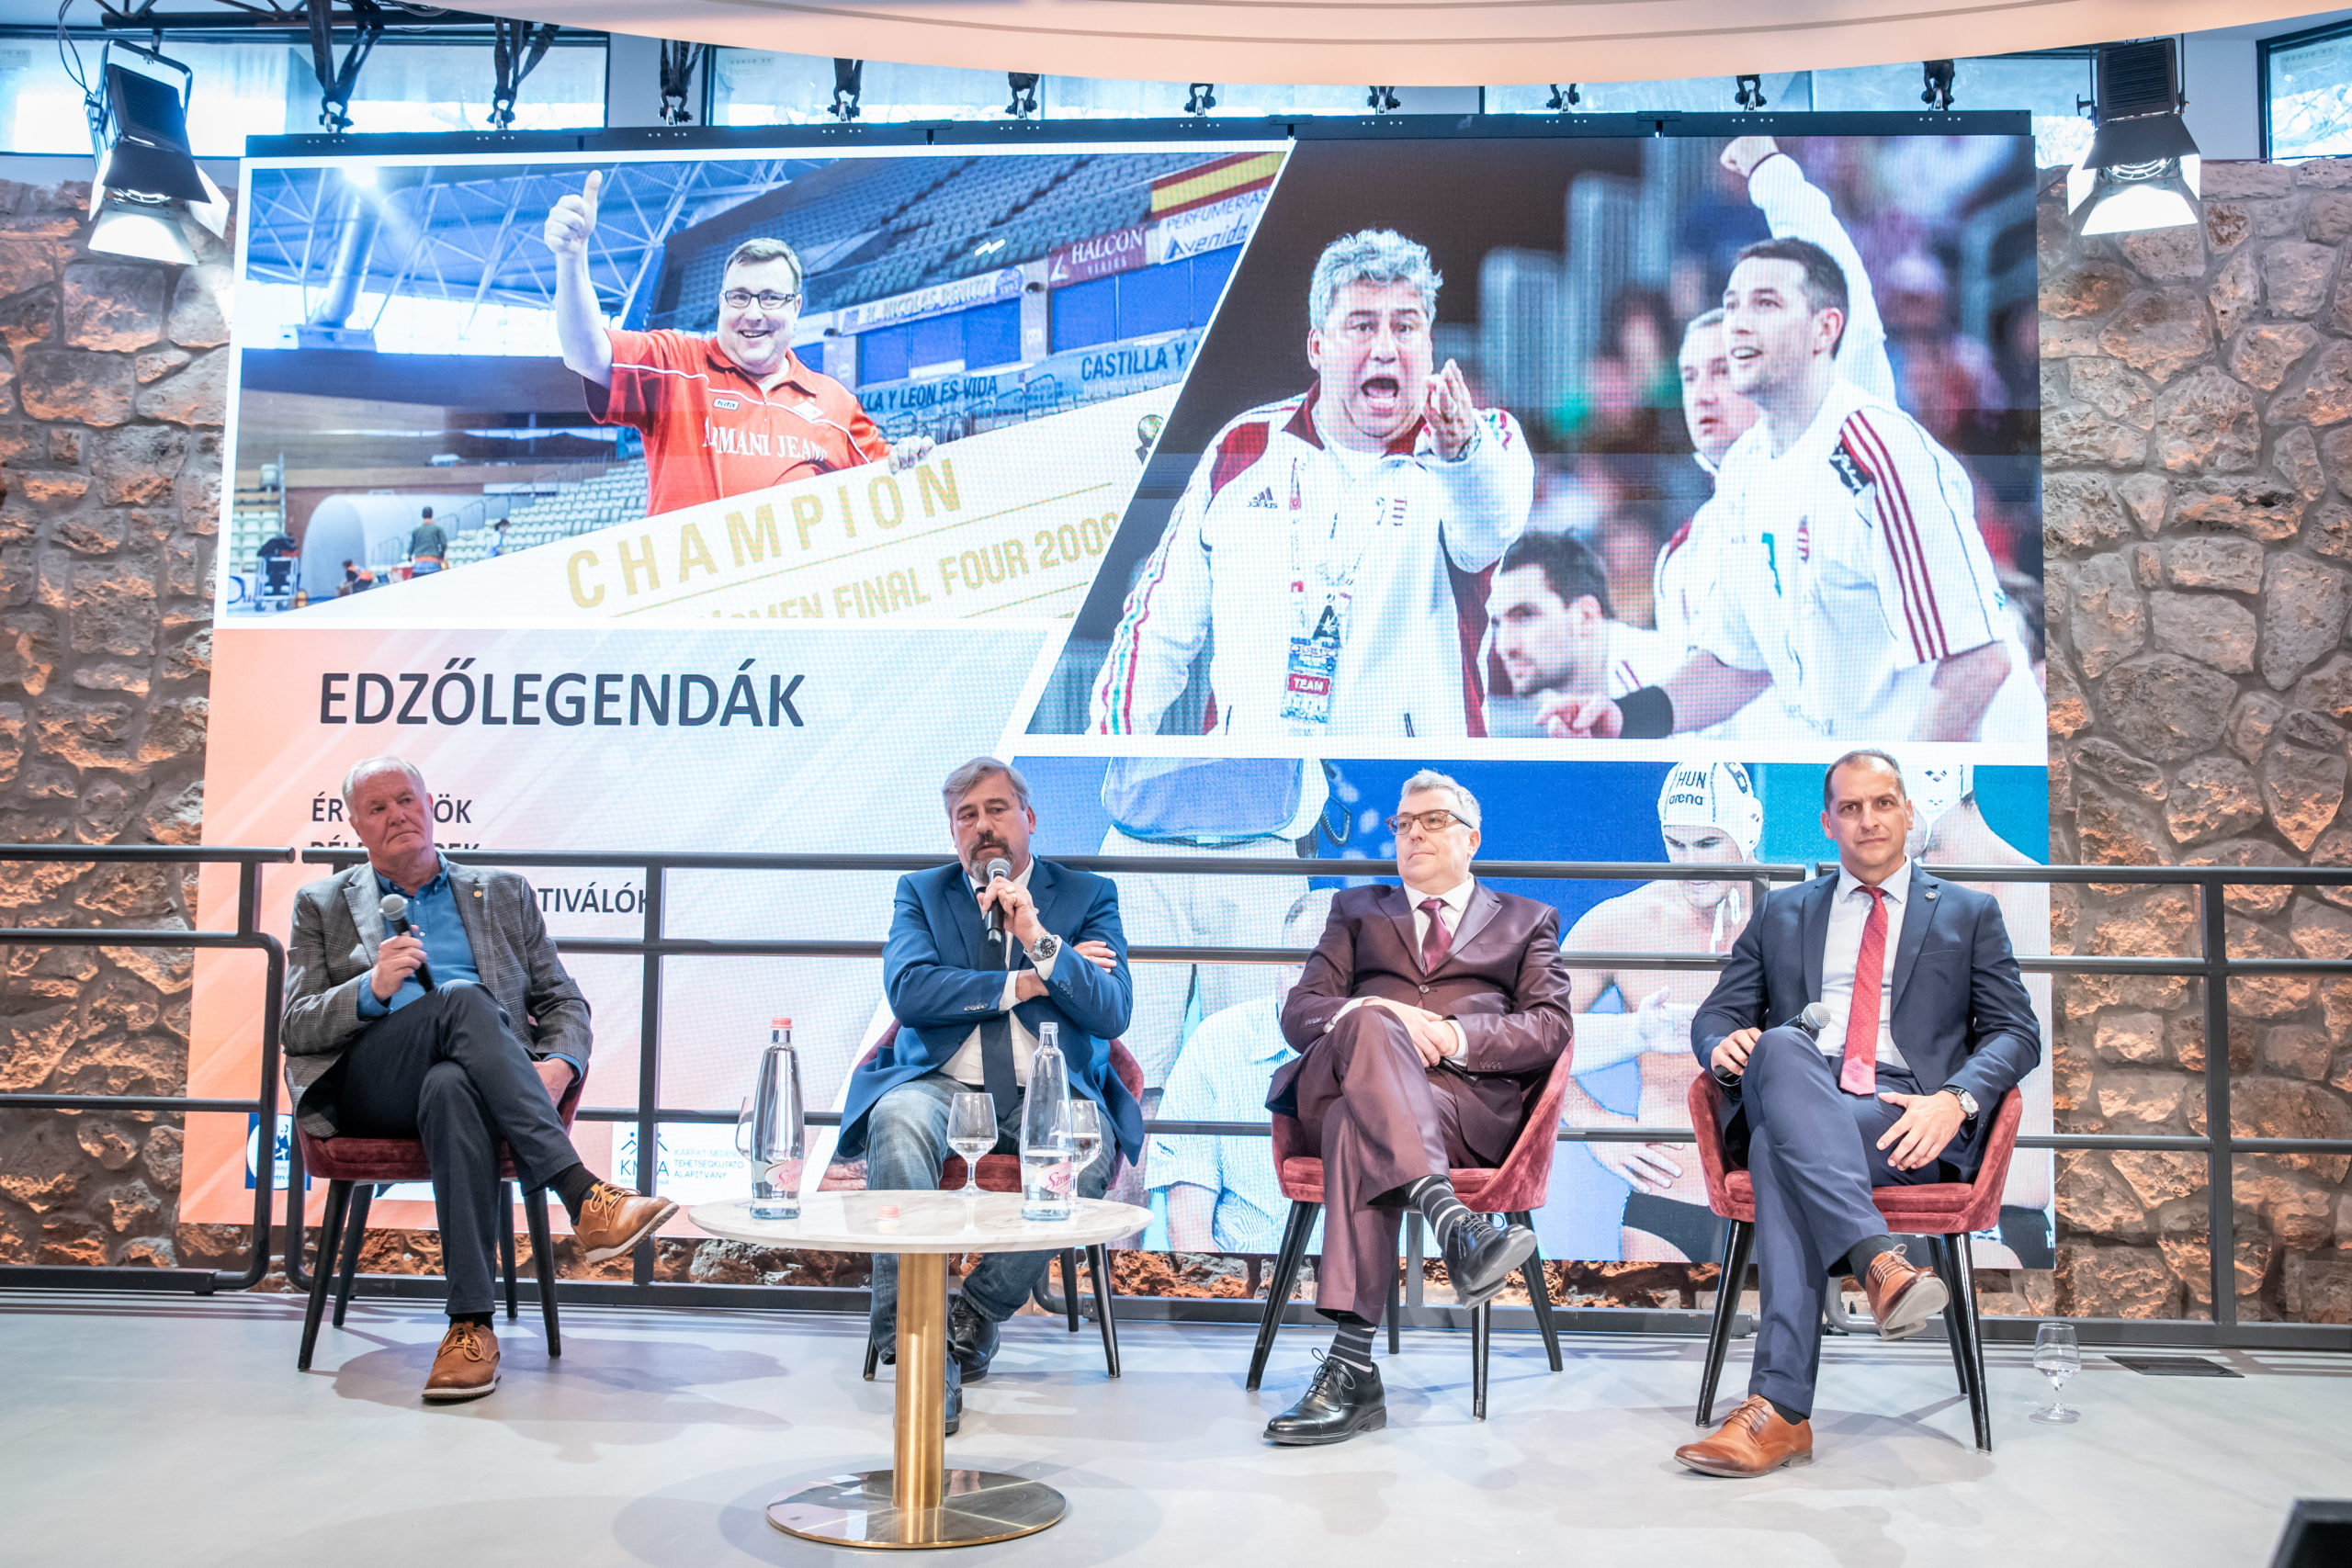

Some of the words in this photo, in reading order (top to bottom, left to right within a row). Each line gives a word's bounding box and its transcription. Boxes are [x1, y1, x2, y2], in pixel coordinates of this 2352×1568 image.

[1071, 227, 1145, 265] HALCON
[1163, 212, 1249, 260] Avenida
[1081, 348, 1168, 381] CASTILLA
[1174, 341, 1186, 367] Y
[888, 389, 898, 411] Y
[940, 379, 959, 404] ES
[963, 376, 998, 400] VIDA
[702, 416, 772, 457] ARMANI
[566, 457, 962, 610] CHAMPION
[832, 567, 931, 618] FINAL
[938, 539, 1030, 596] FOUR
[319, 657, 806, 728] EDZŐLEGENDÁK
[1294, 678, 1324, 693] TEAM
[1676, 770, 1707, 789] HUN
[1668, 793, 1704, 806] arena
[537, 881, 647, 913] TIVÁLÓK
